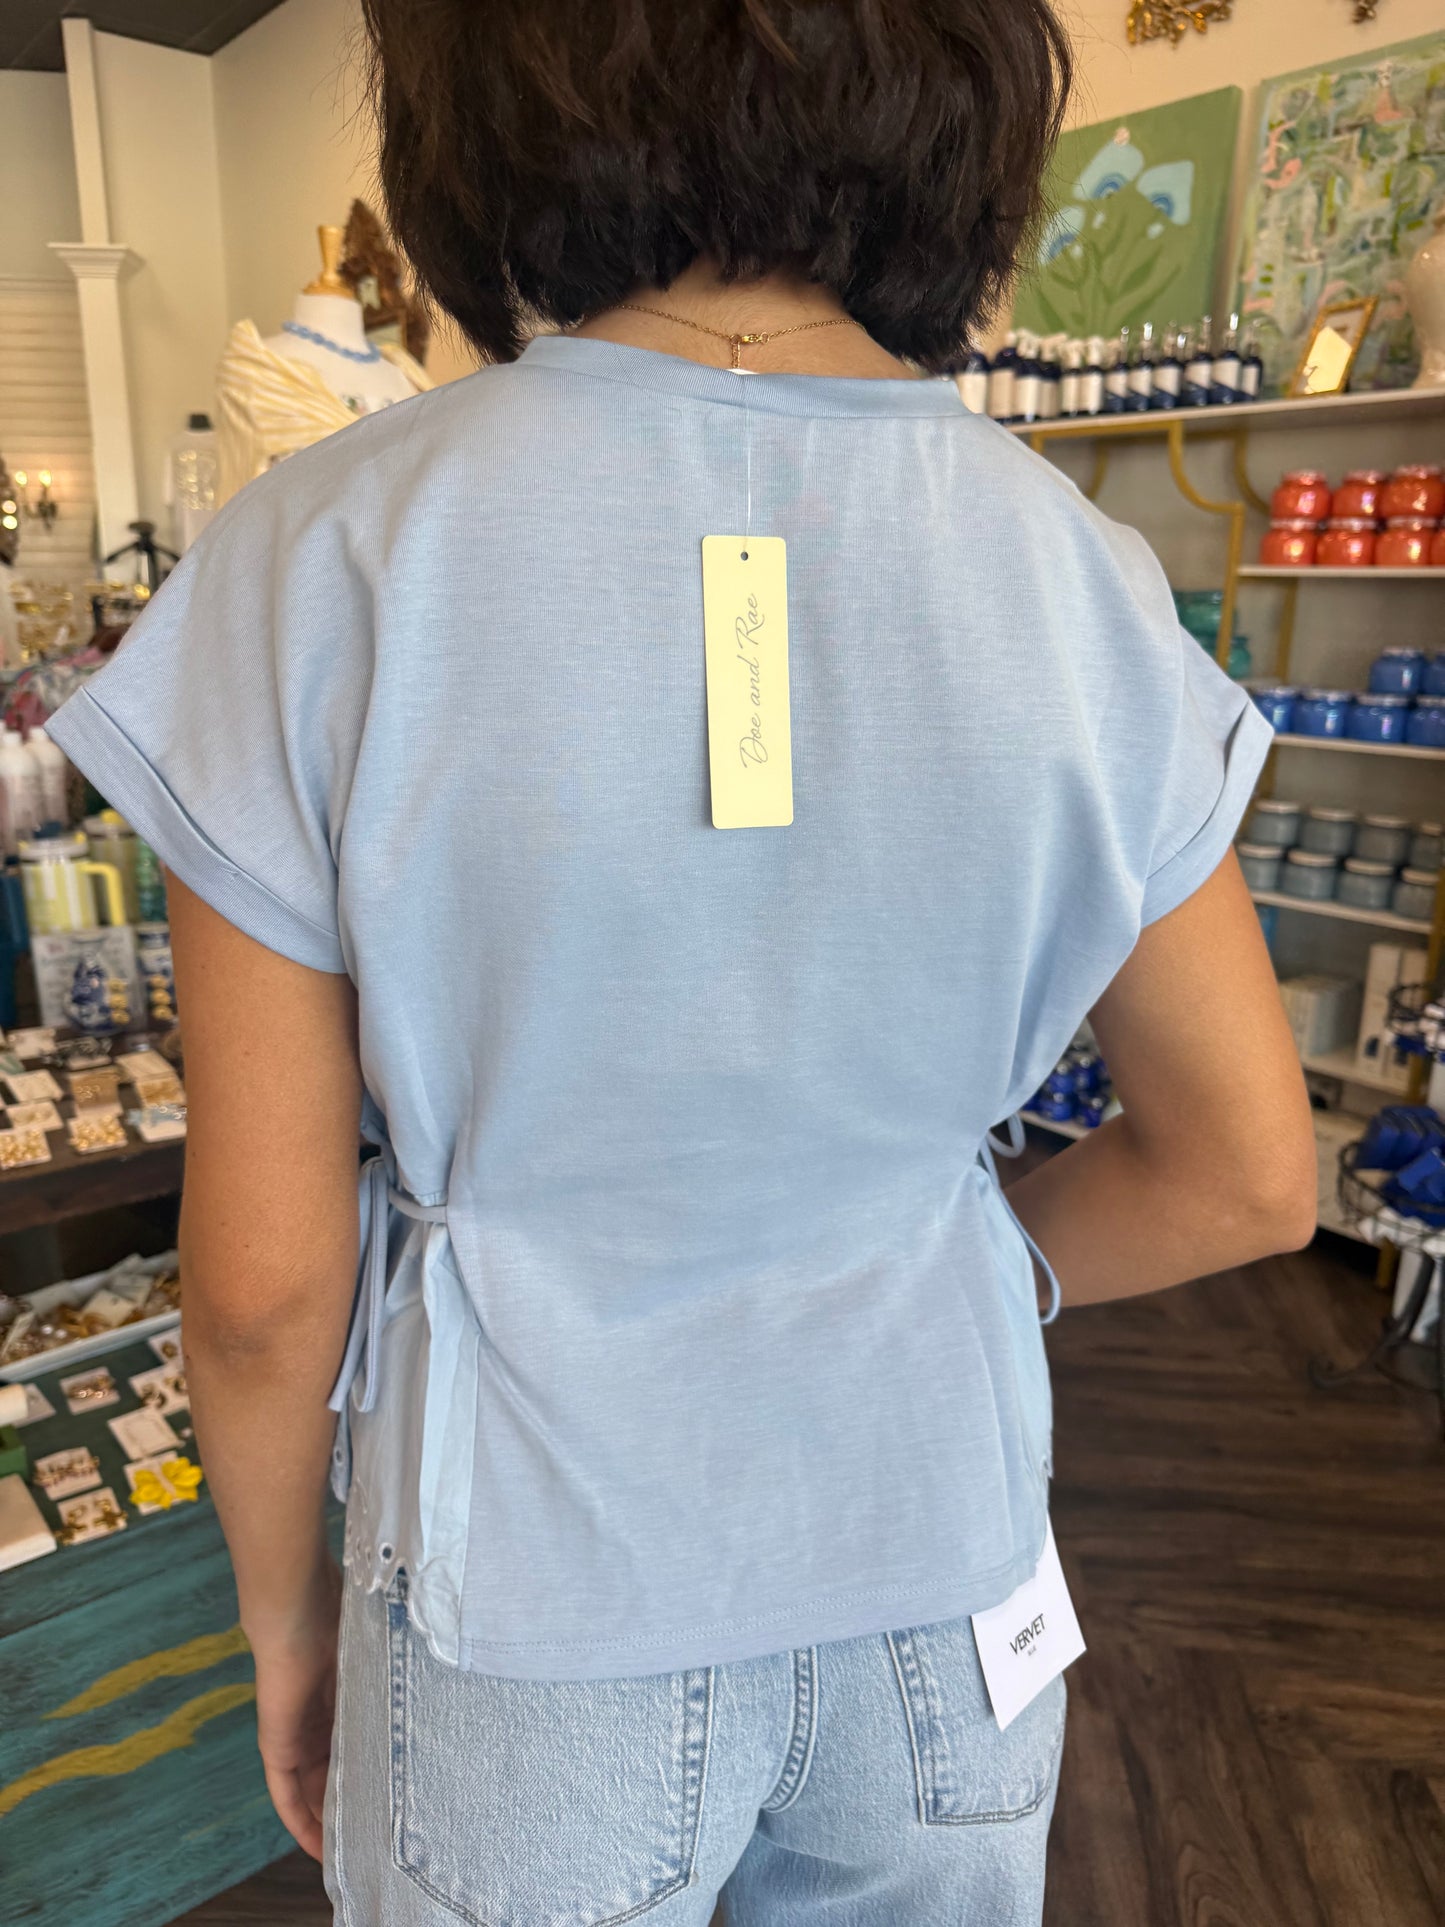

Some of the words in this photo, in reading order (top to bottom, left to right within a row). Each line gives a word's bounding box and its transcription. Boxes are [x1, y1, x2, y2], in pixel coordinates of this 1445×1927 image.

[735, 592, 765, 649] Rae
[737, 654, 760, 706] and
[740, 712, 768, 768] Doe
[1010, 1613, 1046, 1655] VERVET
